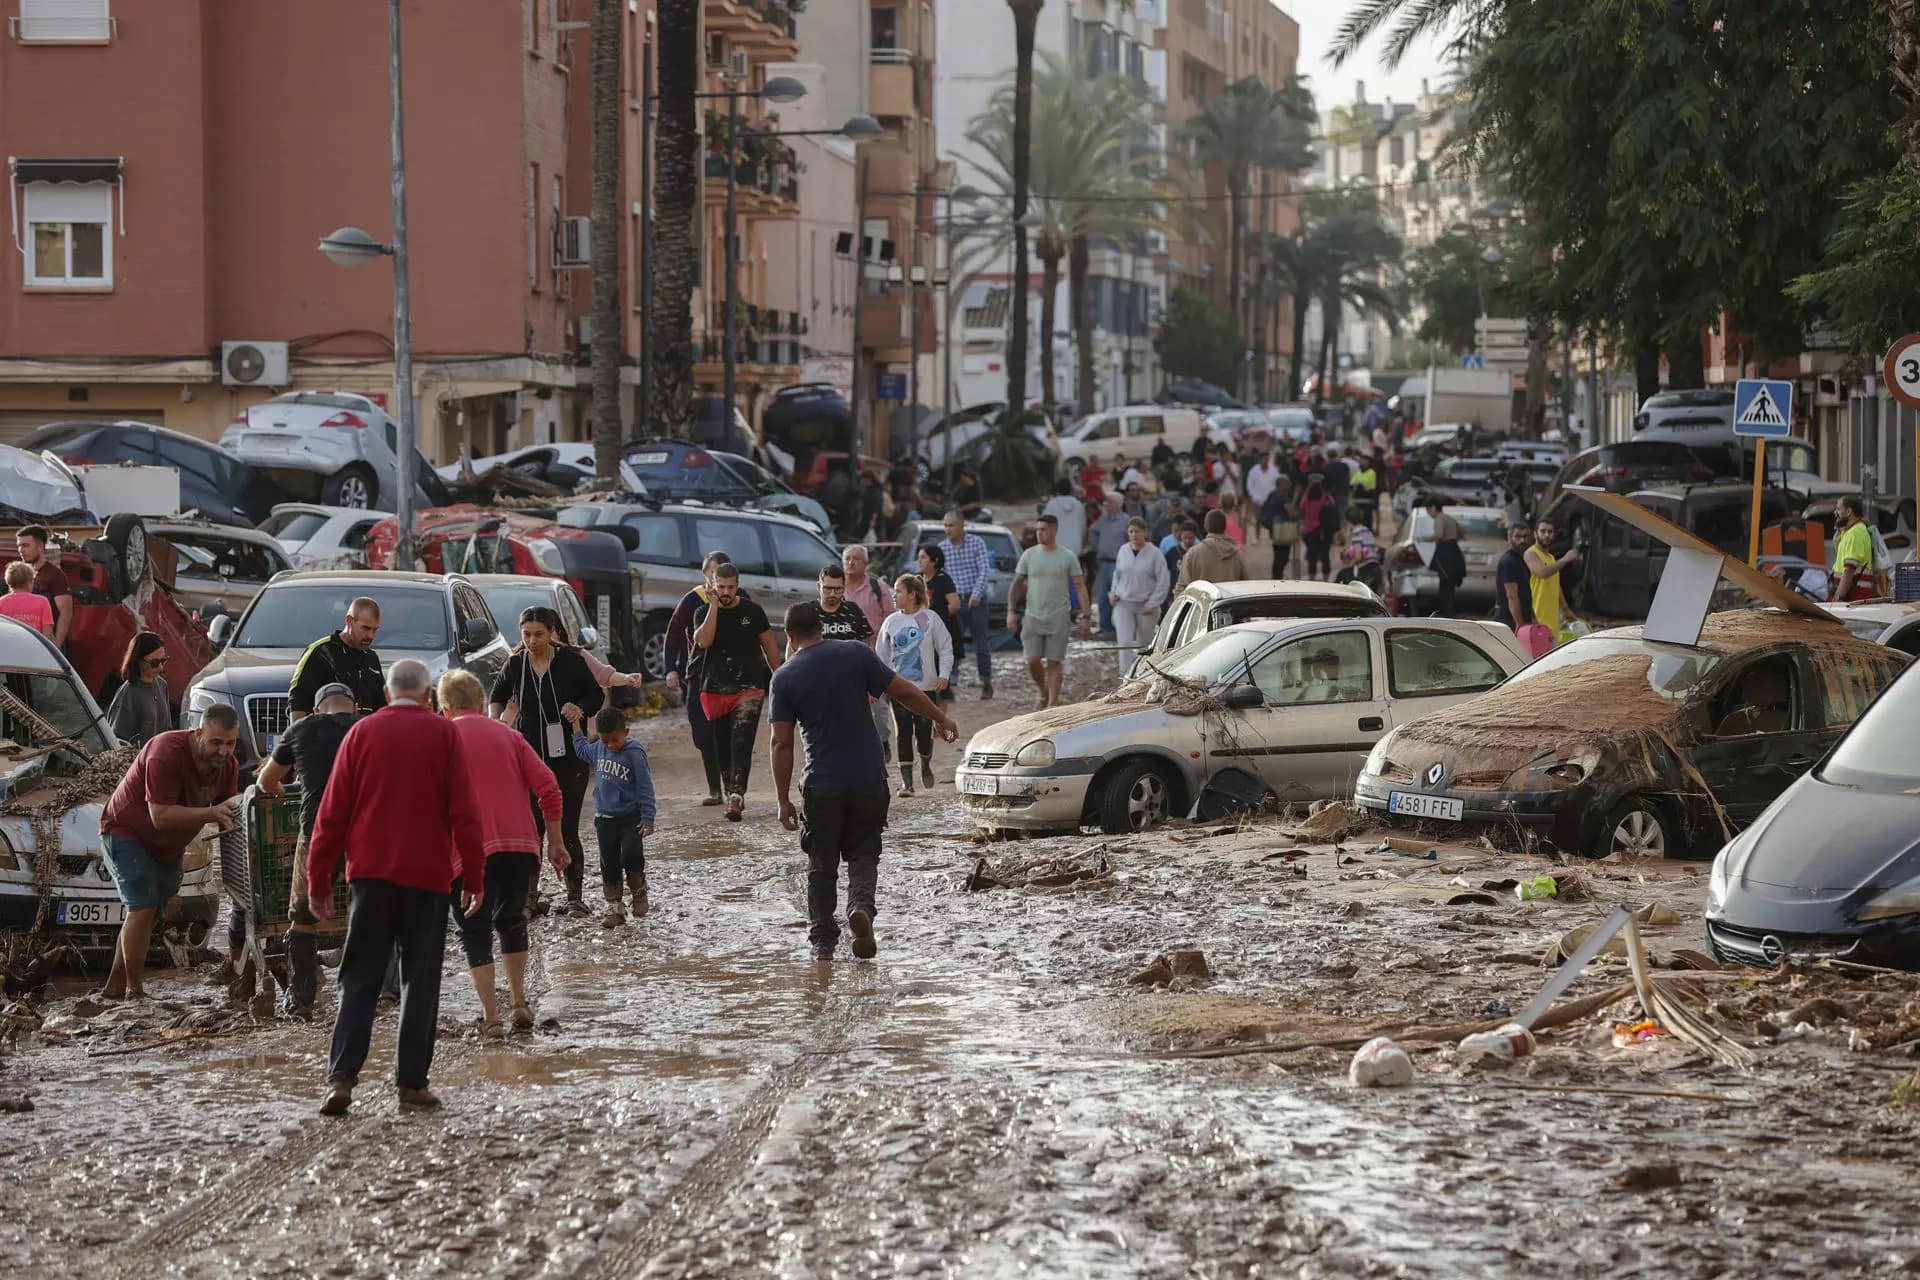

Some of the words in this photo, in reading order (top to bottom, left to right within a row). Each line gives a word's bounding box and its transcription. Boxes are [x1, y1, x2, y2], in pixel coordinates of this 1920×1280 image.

[596, 758, 631, 781] RONX
[1397, 796, 1427, 814] 4581
[1431, 800, 1457, 818] FFL
[70, 904, 109, 921] 9051
